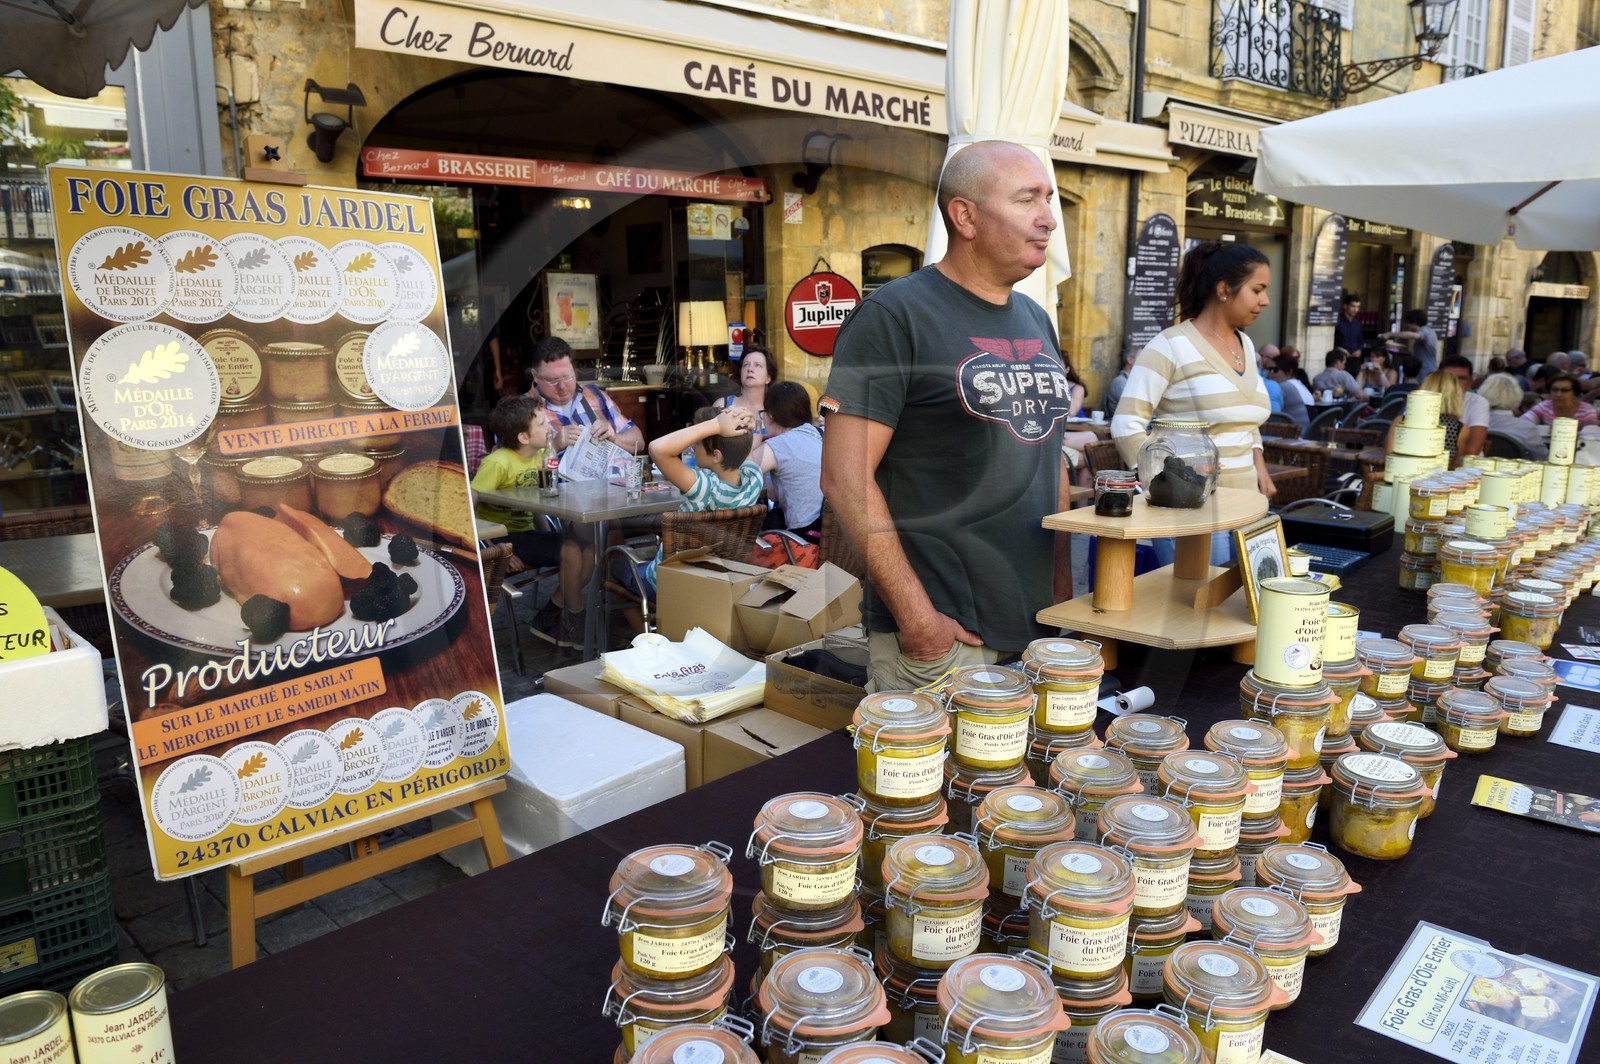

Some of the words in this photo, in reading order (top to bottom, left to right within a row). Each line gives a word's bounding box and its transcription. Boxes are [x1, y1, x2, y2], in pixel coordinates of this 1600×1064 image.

[380, 6, 452, 53] Chez
[467, 21, 574, 72] Bernard
[683, 61, 758, 99] CAFÉ
[771, 76, 812, 107] DU
[825, 94, 931, 127] MARCHÉ
[1179, 120, 1253, 153] PIZZERIA
[366, 149, 400, 161] Chez
[382, 160, 430, 173] Bernard
[437, 159, 532, 179] BRASSERIE
[541, 163, 566, 174] Chez
[552, 172, 587, 186] Bernard
[595, 168, 632, 188] CAFÉ
[636, 173, 659, 190] DU
[662, 174, 720, 194] MARCHÉ
[1209, 178, 1222, 191] Le
[1222, 192, 1248, 204] PIZZERIA
[67, 178, 171, 218] FOIE
[183, 185, 287, 225] GRAS
[299, 194, 425, 234] JARDEL
[1202, 201, 1218, 216] Bar
[1225, 202, 1263, 221] Brasserie
[1349, 219, 1361, 232] Bar
[1364, 221, 1393, 236] Brasserie
[93, 273, 156, 286] MÉDAILLE
[96, 288, 111, 296] DE
[113, 287, 156, 297] BRONZE
[185, 287, 224, 298] BRONZE
[349, 286, 377, 298] D'OR
[99, 296, 128, 307] PARIS
[130, 296, 157, 308] 2013
[199, 298, 224, 308] 2012
[258, 298, 280, 307] 2011
[307, 300, 328, 309] 2011
[973, 370, 1071, 405] SUPER
[114, 387, 194, 404] MÉDAILLE
[133, 402, 176, 419] D'OR
[1012, 400, 1048, 417] DRY
[120, 417, 157, 433] PARIS
[159, 412, 196, 430] 2014
[103, 420, 146, 448] CONCOURS
[146, 437, 183, 448] GÉNÉRAL
[183, 413, 213, 441] AGRICOLE
[223, 428, 283, 451] VENTE
[286, 417, 360, 446] DIRECTE
[365, 419, 375, 433] A
[379, 416, 400, 431] LA
[403, 410, 452, 428] FERME
[1302, 617, 1321, 626] Foie
[1295, 627, 1319, 636] d'Oie
[1298, 635, 1310, 643] du
[142, 618, 394, 708] Producteur
[680, 662, 706, 677] Gras
[161, 714, 192, 734] SUR
[197, 708, 215, 724] LE
[219, 687, 278, 719] MARCHÉ
[281, 683, 300, 700] DE
[304, 668, 355, 694] SARLAT
[1052, 702, 1067, 712] Foie
[1068, 702, 1084, 711] Gras
[138, 744, 159, 761] LE
[162, 723, 241, 753] MERCREDI
[245, 716, 263, 731] ET
[266, 711, 284, 727] LE
[287, 692, 339, 719] SAMEDI
[340, 680, 381, 702] MATIN
[961, 728, 977, 738] Foie
[979, 732, 996, 741] Gras
[997, 731, 1014, 741] d'Oie
[344, 755, 380, 772] BRONZE
[358, 767, 375, 778] 2007
[883, 768, 900, 778] Foie
[903, 768, 920, 778] Gras
[921, 766, 937, 777] d'Oie
[169, 788, 228, 811] MÉDAILLE
[242, 785, 283, 803] BRONZE
[259, 796, 279, 809] 2010
[171, 798, 229, 822] D'ARGENT
[176, 833, 251, 869] 24370
[258, 800, 360, 843] CALVIAC
[366, 788, 394, 810] EN
[401, 757, 498, 800] PÉRIGORD
[180, 818, 203, 830] PARIS
[1208, 820, 1224, 828] Foie
[1137, 876, 1156, 886] Foie
[1157, 877, 1174, 886] Gras
[1187, 905, 1203, 914] Foie
[923, 925, 943, 935] Foie
[945, 924, 965, 935] Gras
[1314, 921, 1329, 929] Foie
[945, 934, 956, 943] du
[1060, 933, 1080, 944] Foie
[1082, 936, 1102, 946] Gras
[1104, 931, 1121, 944] d'Oie
[661, 949, 678, 957] Foie
[680, 947, 697, 956] Gras
[1082, 945, 1093, 954] du
[639, 957, 651, 965] 120
[1138, 969, 1156, 978] Foie
[1285, 971, 1298, 981] Gras
[1382, 1005, 1405, 1031] Foie
[1398, 982, 1424, 1010] Gras
[1413, 958, 1438, 989] d'Oie
[1430, 936, 1453, 963] Entier
[1435, 976, 1461, 1005] Mi-Cuit)
[1432, 999, 1443, 1013] ou
[104, 1022, 125, 1034] Jean
[128, 1006, 159, 1029] JARDEL
[1419, 1009, 1440, 1030] (Cuit
[88, 1035, 104, 1044] 24370
[106, 1027, 137, 1044] CALVIAC
[137, 1026, 148, 1035] EN
[1441, 1020, 1456, 1037] Bocal
[1459, 1021, 1474, 1039] 23.00
[1055, 1038, 1073, 1049] Foie
[1228, 1039, 1246, 1048] Foie
[1475, 1028, 1490, 1045] 33.00
[1492, 1033, 1507, 1051] 49.00
[33, 1034, 65, 1060] JARDEL
[1452, 1038, 1468, 1053] 120g
[1468, 1045, 1485, 1060] 190g
